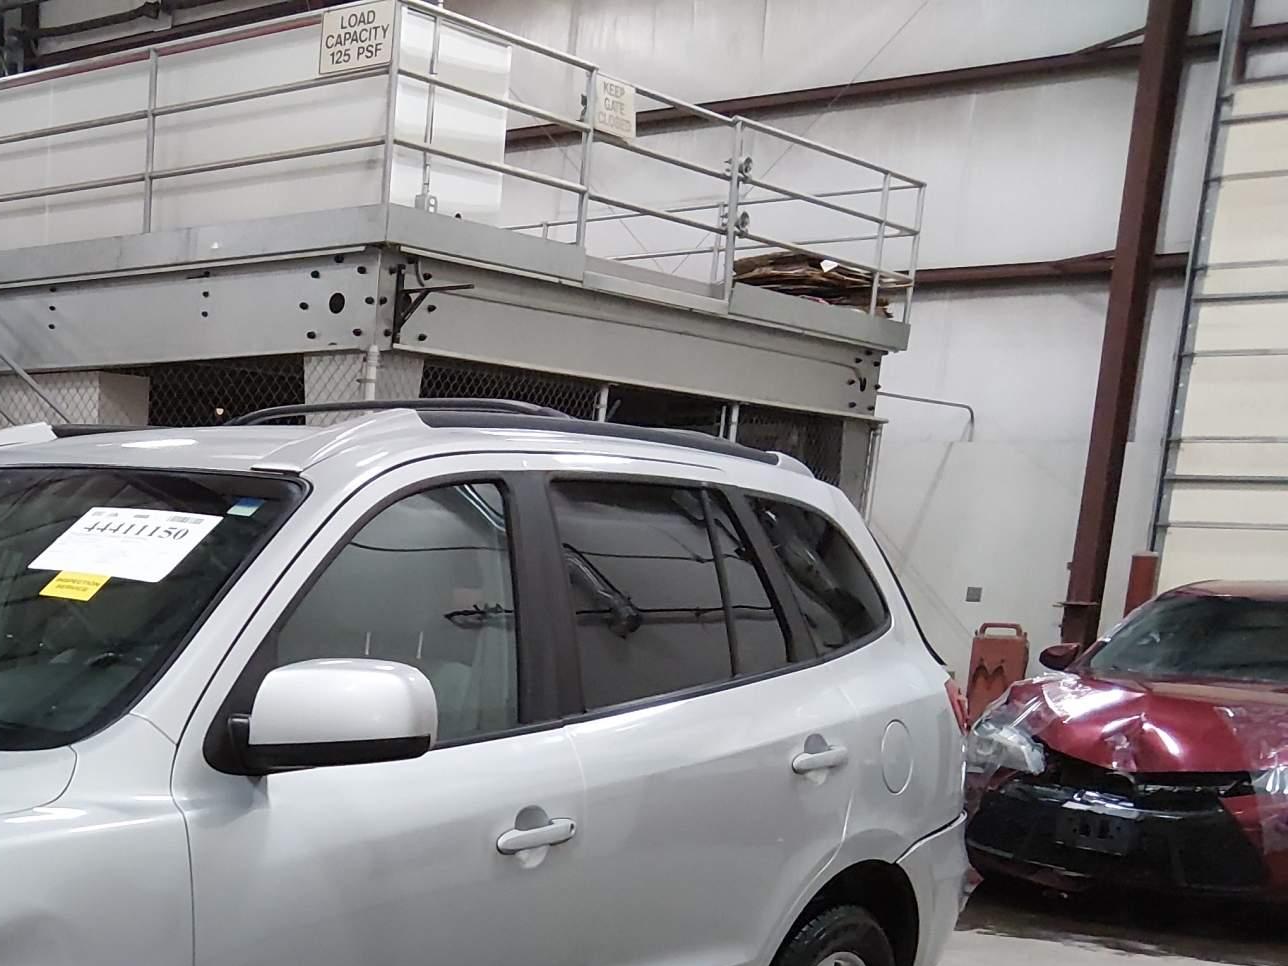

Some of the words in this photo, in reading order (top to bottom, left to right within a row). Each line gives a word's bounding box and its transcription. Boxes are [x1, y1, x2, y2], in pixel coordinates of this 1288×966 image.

[340, 10, 376, 30] LOAD
[325, 24, 390, 49] CAPACITY
[329, 49, 351, 65] 125
[356, 43, 383, 61] PSF
[603, 81, 625, 98] KEEP
[604, 97, 625, 116] GATE
[83, 521, 189, 540] 44411150
